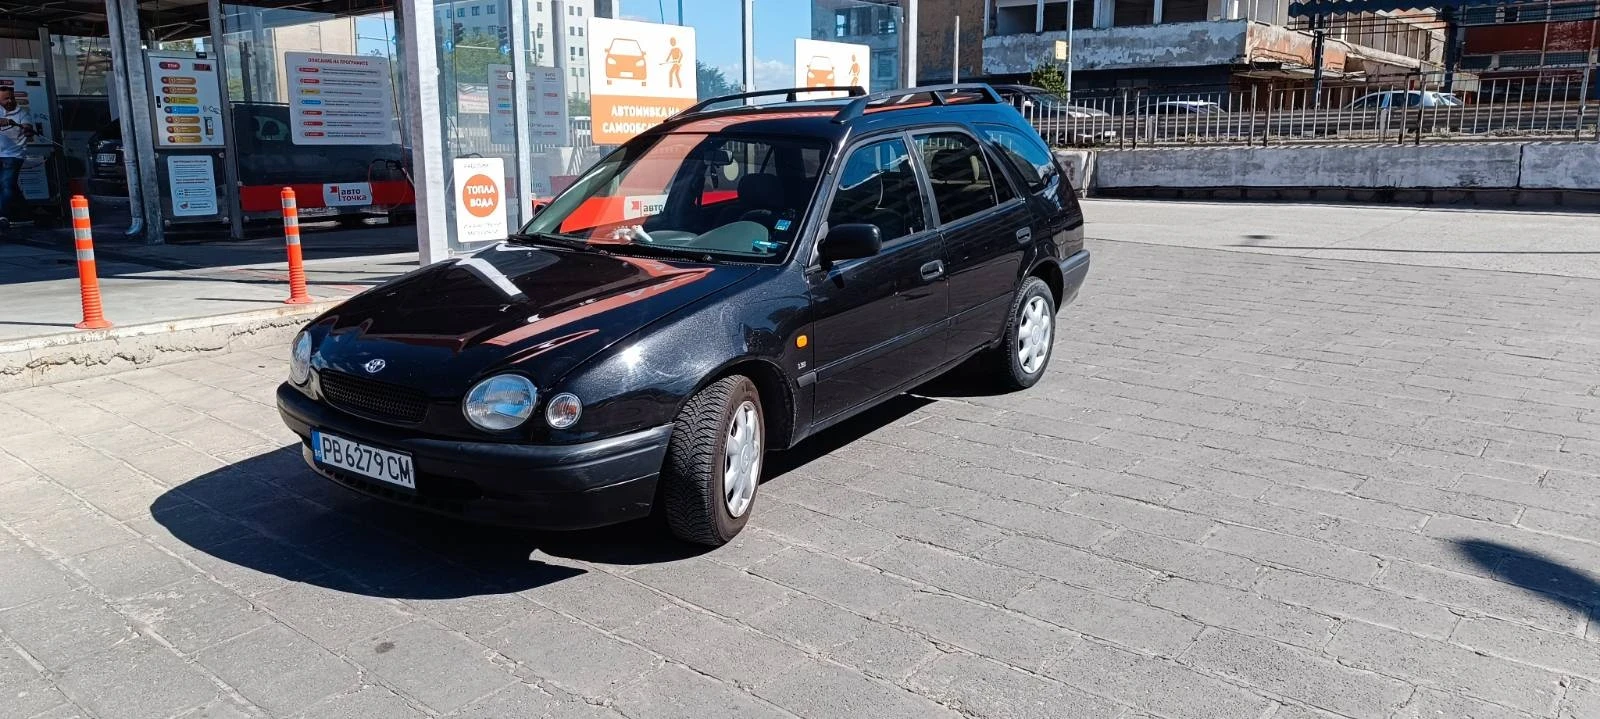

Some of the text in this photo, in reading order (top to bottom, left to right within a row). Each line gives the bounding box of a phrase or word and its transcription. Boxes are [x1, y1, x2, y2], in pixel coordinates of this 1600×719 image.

[611, 105, 668, 118] АВТОМИВКА
[467, 185, 495, 194] ТОПЛА
[470, 198, 494, 208] ВОДА
[643, 204, 664, 212] авто
[345, 443, 384, 476] 6279
